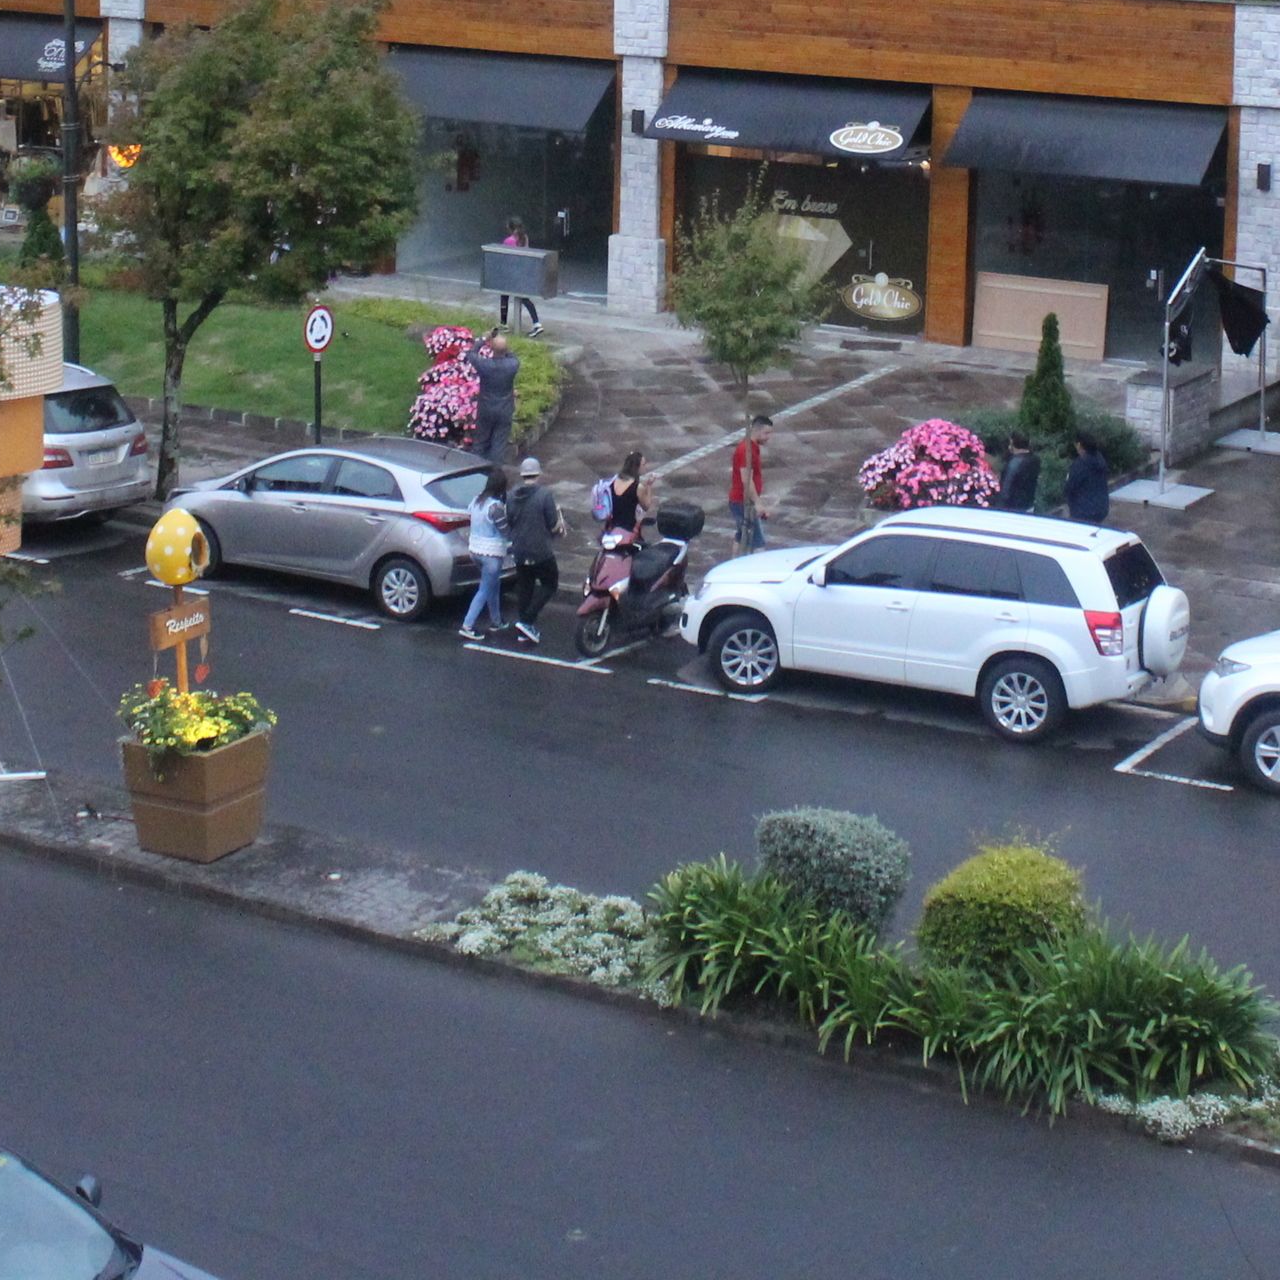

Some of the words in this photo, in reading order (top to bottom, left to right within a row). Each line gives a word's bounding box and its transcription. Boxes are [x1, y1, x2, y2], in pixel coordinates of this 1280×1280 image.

[839, 130, 869, 145] Gold
[867, 131, 892, 146] Chic
[772, 190, 798, 211] Em
[852, 286, 882, 309] Gold
[883, 289, 911, 309] Chic
